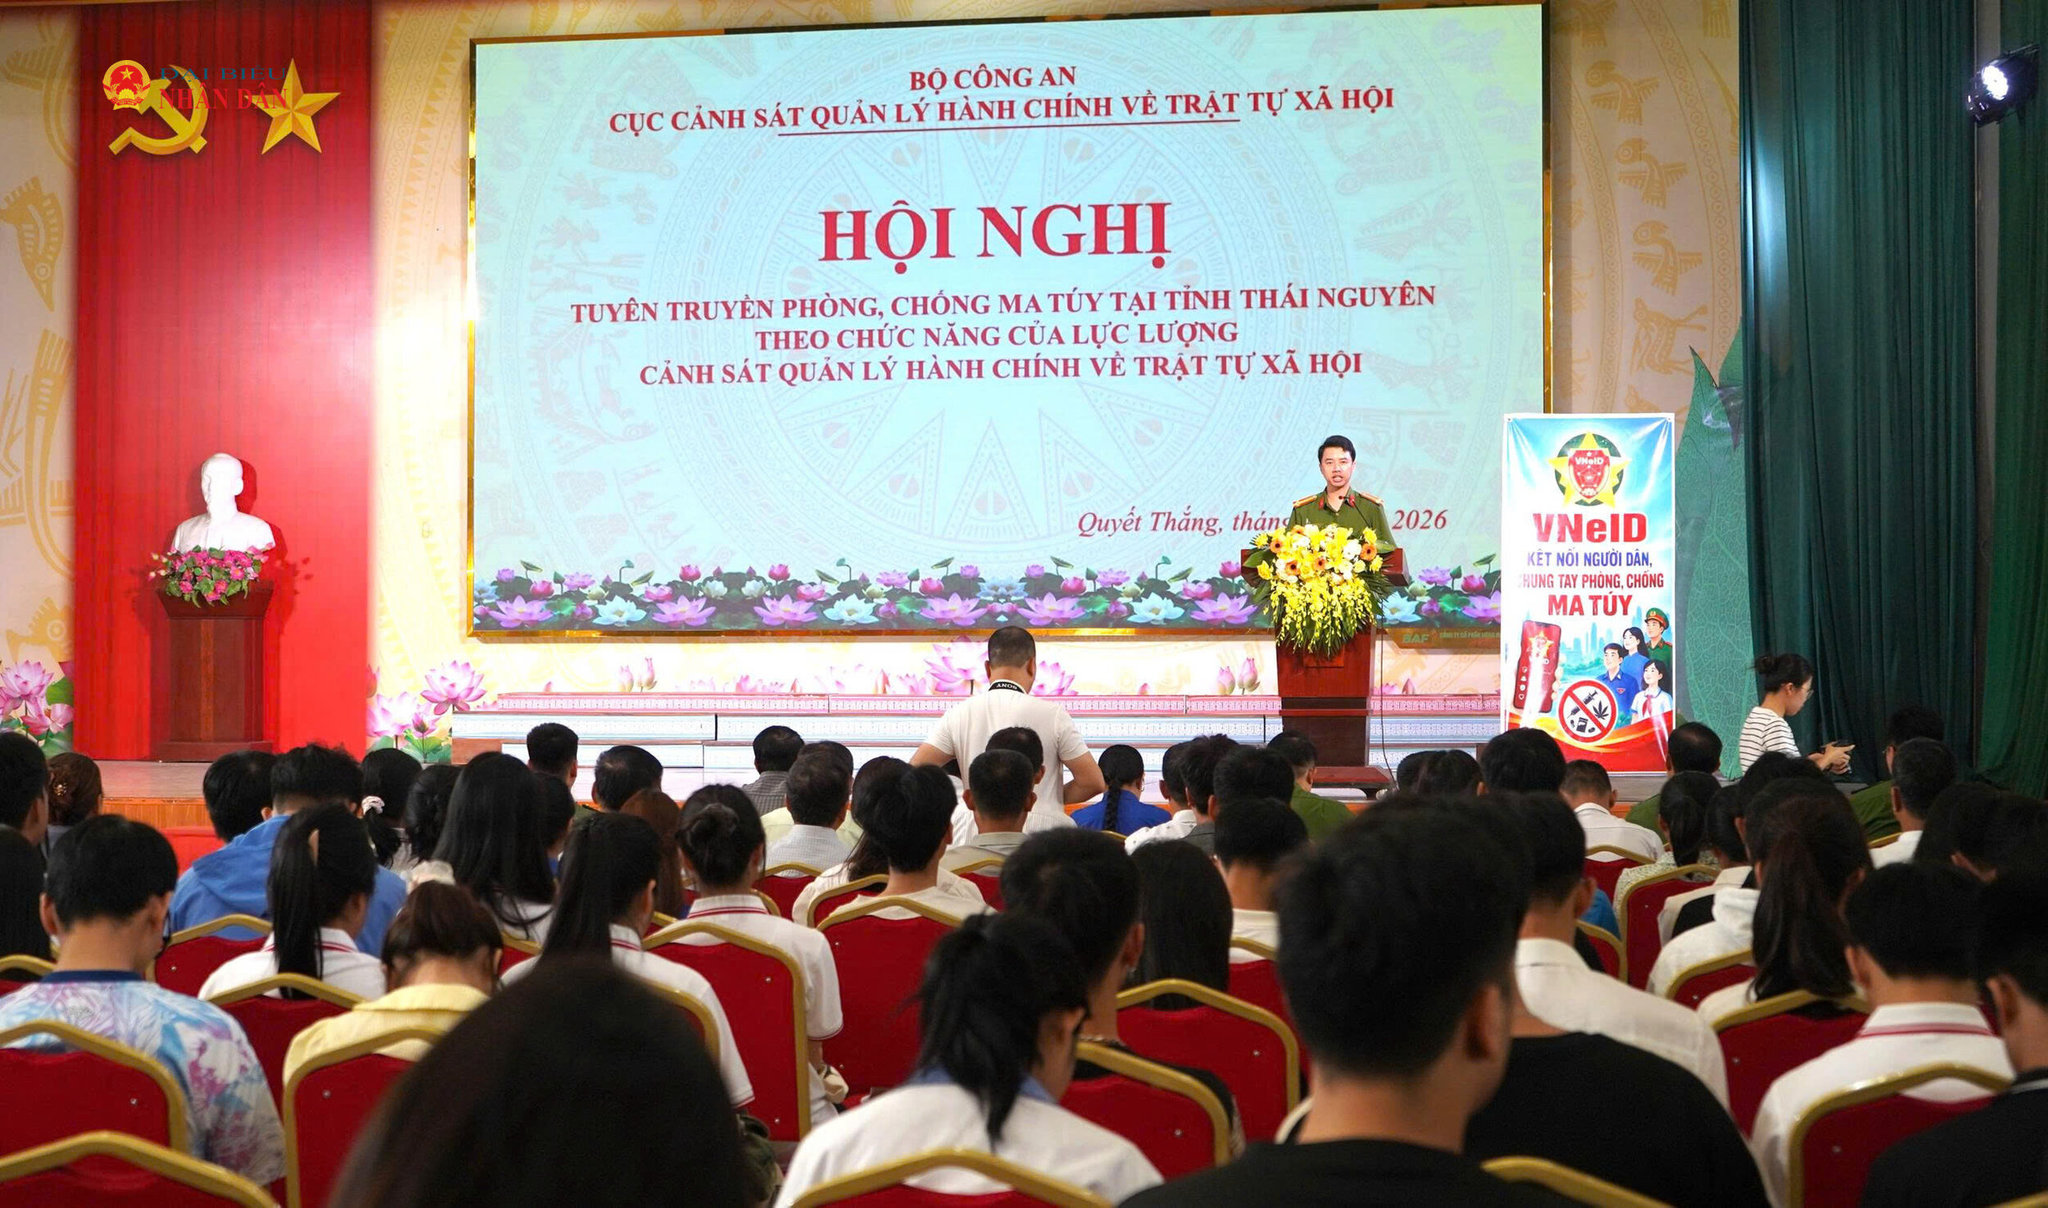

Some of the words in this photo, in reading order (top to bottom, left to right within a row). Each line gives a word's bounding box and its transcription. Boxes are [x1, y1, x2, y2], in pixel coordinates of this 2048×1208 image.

[910, 67, 948, 95] BỘ
[954, 63, 1033, 88] CÔNG
[1039, 66, 1077, 86] AN
[609, 112, 664, 136] CỤC
[671, 105, 746, 131] CẢNH
[755, 102, 806, 128] SÁT
[811, 99, 887, 130] QUẢN
[895, 96, 932, 123] LÝ
[936, 95, 1016, 122] HÀNH
[1023, 91, 1113, 118] CHÍNH
[1121, 88, 1158, 116] VỀ
[1165, 90, 1240, 118] TRẬT
[1246, 89, 1289, 117] TỰ
[1294, 85, 1334, 112] XÃ
[1341, 85, 1394, 113] HỘI
[818, 199, 956, 274] HỘI
[977, 202, 1172, 270] NGHỊ
[571, 297, 659, 323] TUYÊN
[666, 294, 774, 320] TRUYỀN
[782, 292, 884, 320] PHÒNG,
[891, 290, 990, 316] CHỐNG
[999, 294, 1042, 313] MA
[1048, 287, 1104, 313] TÚY
[1111, 292, 1157, 317] TẠI
[1165, 285, 1231, 310] TỈNH
[1241, 282, 1309, 309] THÁI
[1317, 280, 1436, 307] NGUYÊN
[755, 330, 830, 351] THEO
[837, 322, 915, 349] CHỨC
[924, 323, 1001, 347] NĂNG
[1008, 320, 1065, 346] CỦA
[1073, 322, 1130, 349] LỰC
[1138, 321, 1239, 348] LƯỢNG
[640, 360, 715, 385] CẢNH
[722, 358, 772, 384] SÁT
[778, 357, 854, 387] QUẢN
[863, 356, 898, 381] LÝ
[907, 355, 984, 380] HÀNH
[992, 353, 1081, 379] CHÍNH
[1089, 350, 1126, 377] VỀ
[1133, 352, 1208, 380] TRẬT
[1216, 352, 1257, 379] TỰ
[1262, 349, 1300, 375] XÃ
[1309, 350, 1363, 378] HỘI
[1077, 506, 1141, 537] Quyết
[1150, 505, 1223, 536] Thắng,
[1392, 509, 1447, 531] 2026
[1532, 513, 1647, 543] VNeID
[1556, 547, 1579, 567] NỐI
[1584, 548, 1622, 567] NGƯỜI
[1626, 548, 1653, 568] DÂN,
[1519, 574, 1555, 589] HUNG
[1558, 574, 1578, 589] TAY
[1582, 571, 1624, 590] PHÒNG,
[1626, 570, 1665, 588] CHỐNG
[1548, 594, 1585, 616] MA
[1588, 590, 1633, 616] TÚY
